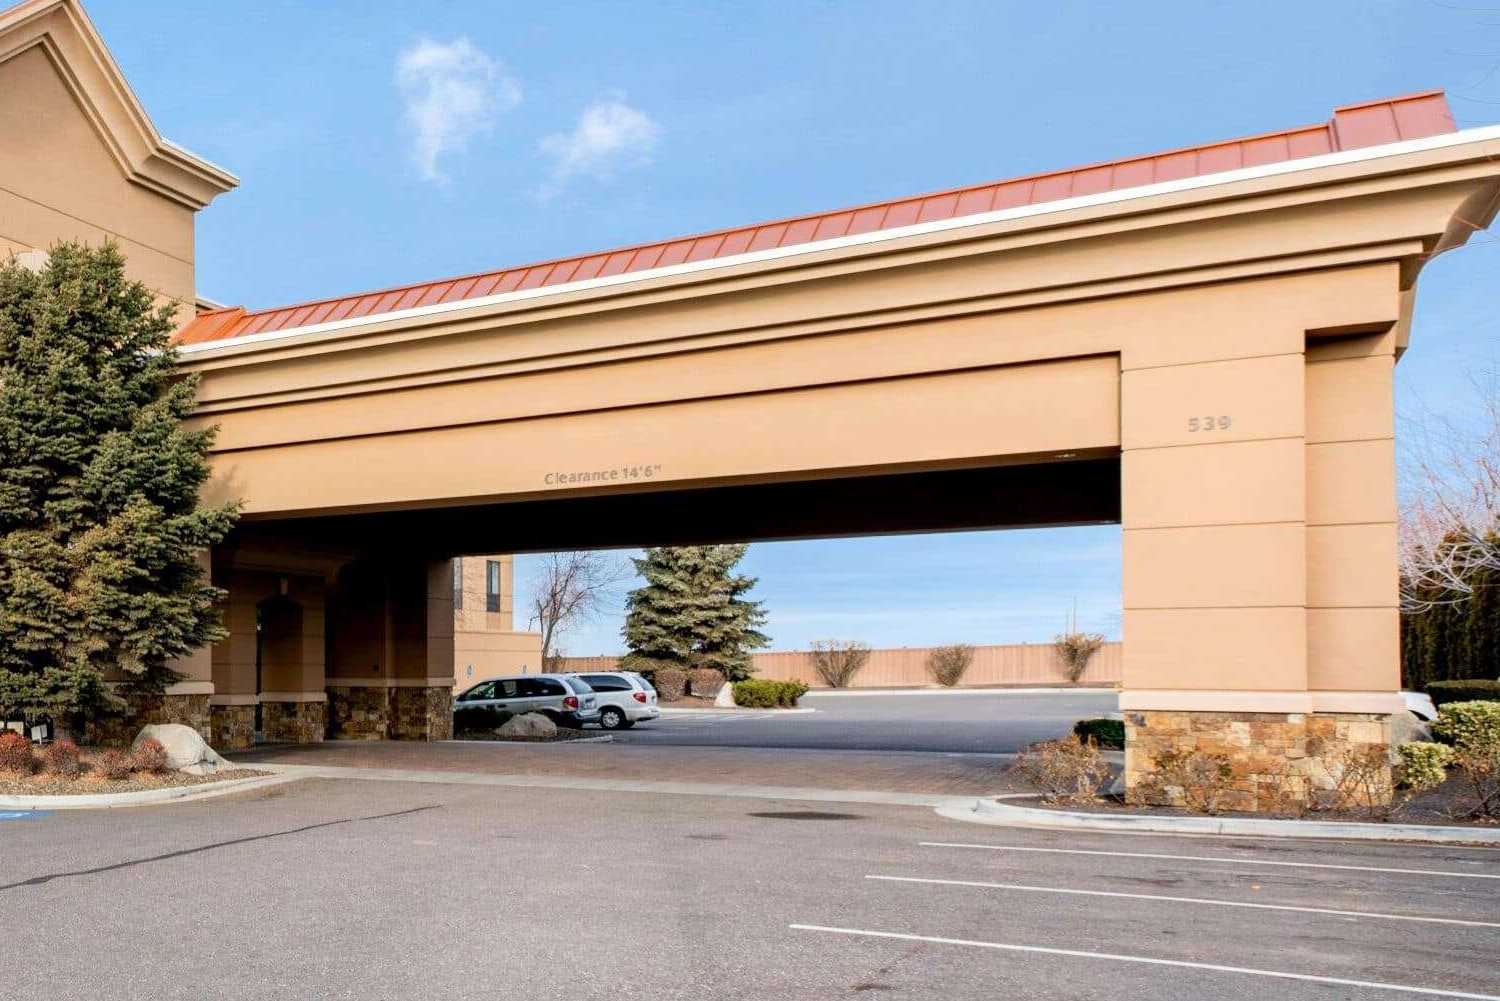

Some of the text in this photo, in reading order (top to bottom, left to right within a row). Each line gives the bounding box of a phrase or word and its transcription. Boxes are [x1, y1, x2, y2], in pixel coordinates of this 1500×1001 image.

[1187, 415, 1232, 432] 539
[544, 464, 661, 485] Clearance 14'6"
